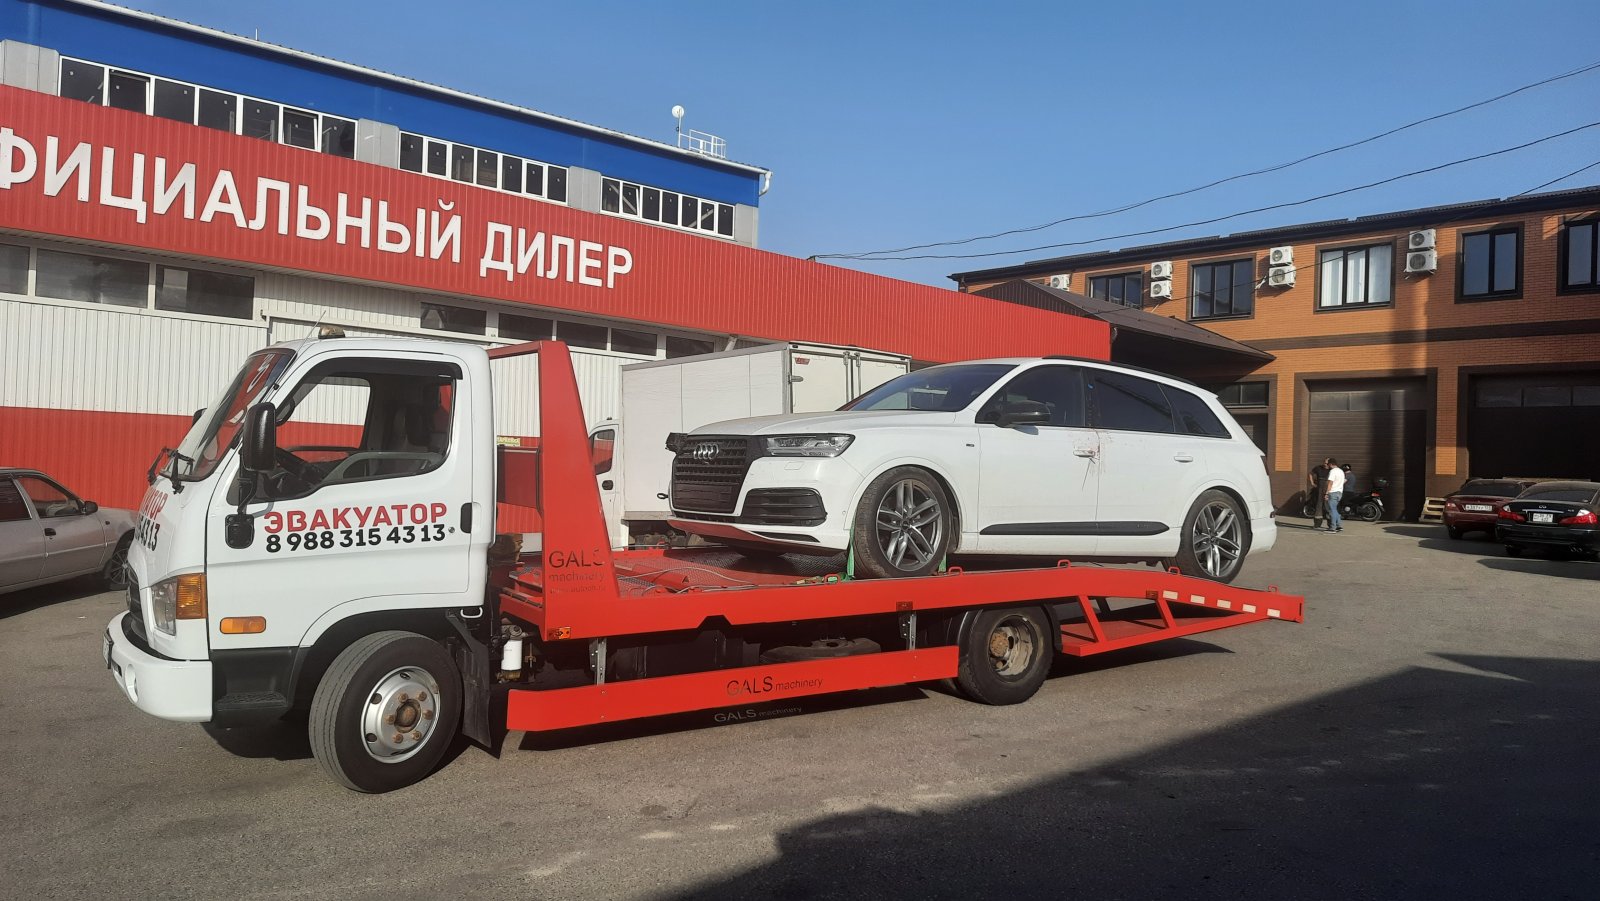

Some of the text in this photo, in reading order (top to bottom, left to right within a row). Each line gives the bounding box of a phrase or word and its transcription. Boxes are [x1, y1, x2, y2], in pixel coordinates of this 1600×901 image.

[479, 221, 633, 289] ДИЛЕР
[264, 502, 448, 534] ЭВАКУАТОР
[286, 531, 335, 552] 988
[339, 527, 382, 548] 315
[726, 676, 824, 697] GALS machinery
[714, 706, 803, 723] GALS machinery
